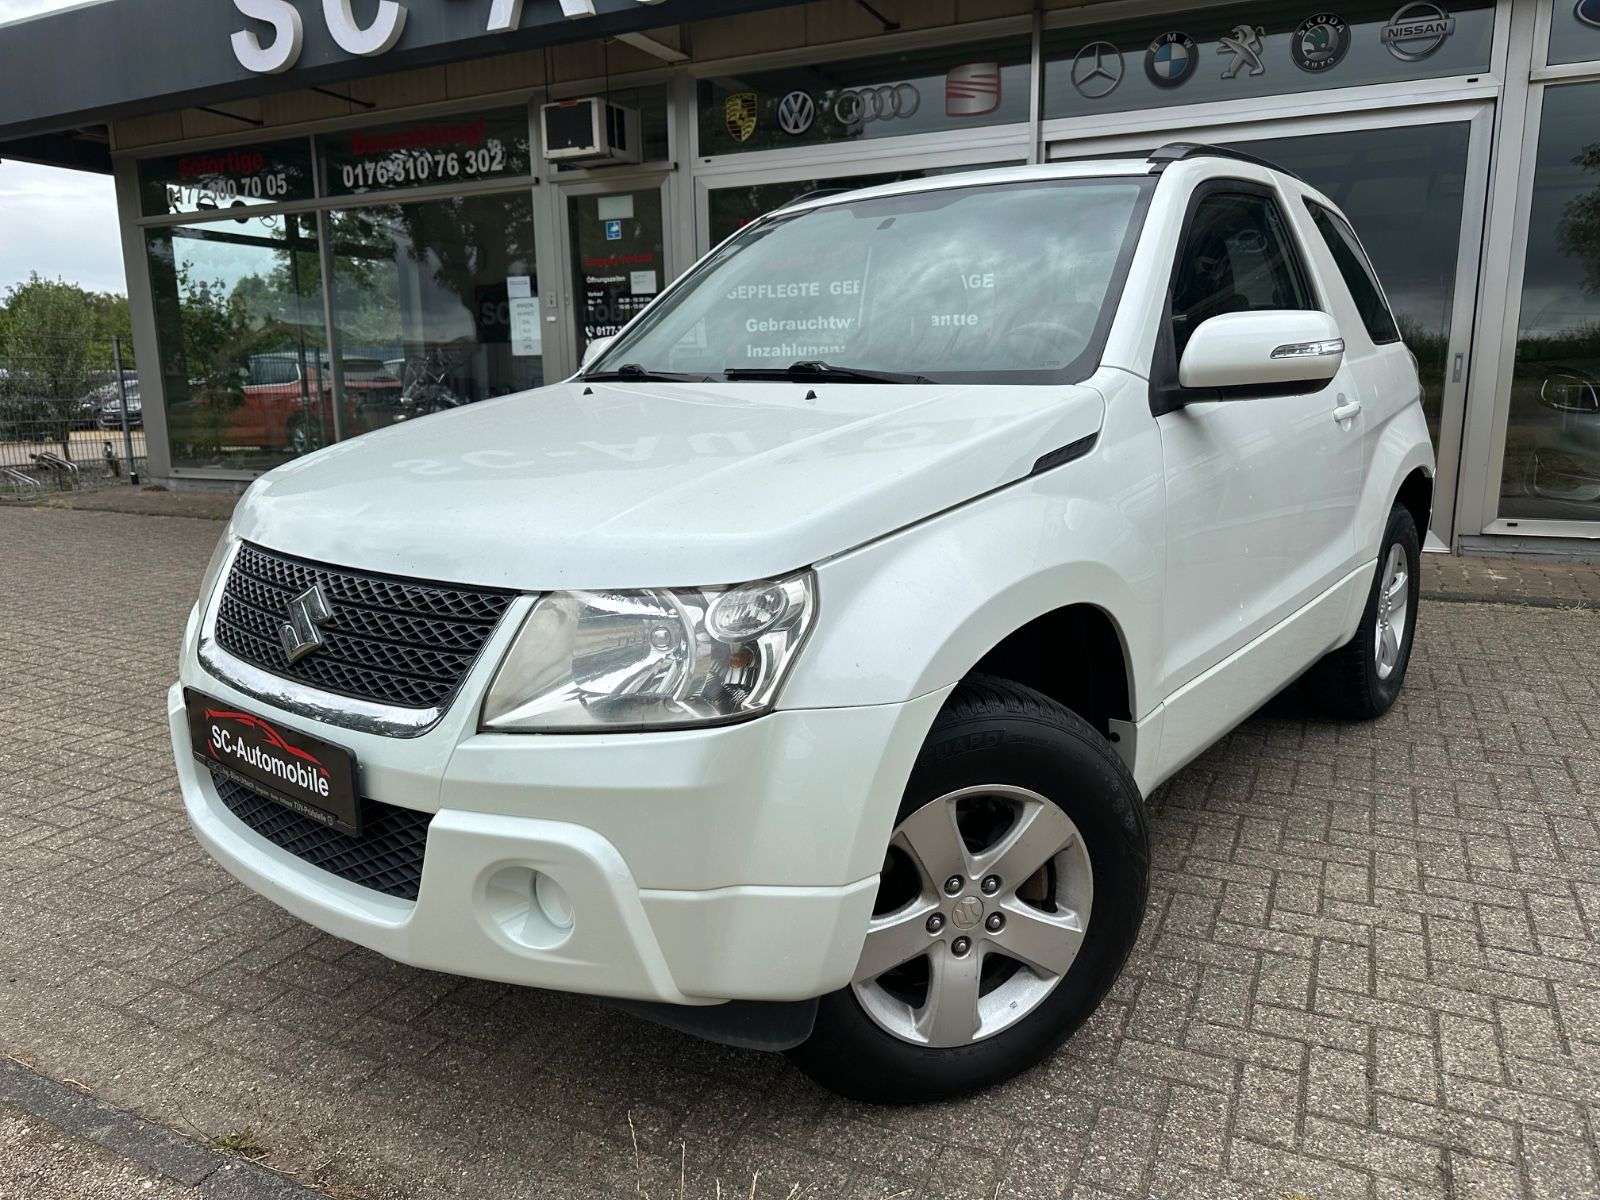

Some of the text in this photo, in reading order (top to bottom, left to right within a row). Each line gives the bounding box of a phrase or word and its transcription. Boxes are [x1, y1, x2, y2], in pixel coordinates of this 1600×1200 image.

[1388, 21, 1448, 38] NISSAN
[1303, 57, 1335, 68] AUTO
[434, 153, 459, 177] 76
[465, 147, 504, 174] 302
[241, 176, 261, 198] 70
[266, 173, 288, 196] 05
[746, 315, 856, 333] Gebrauchtw
[211, 724, 329, 797] SC-Automobile
